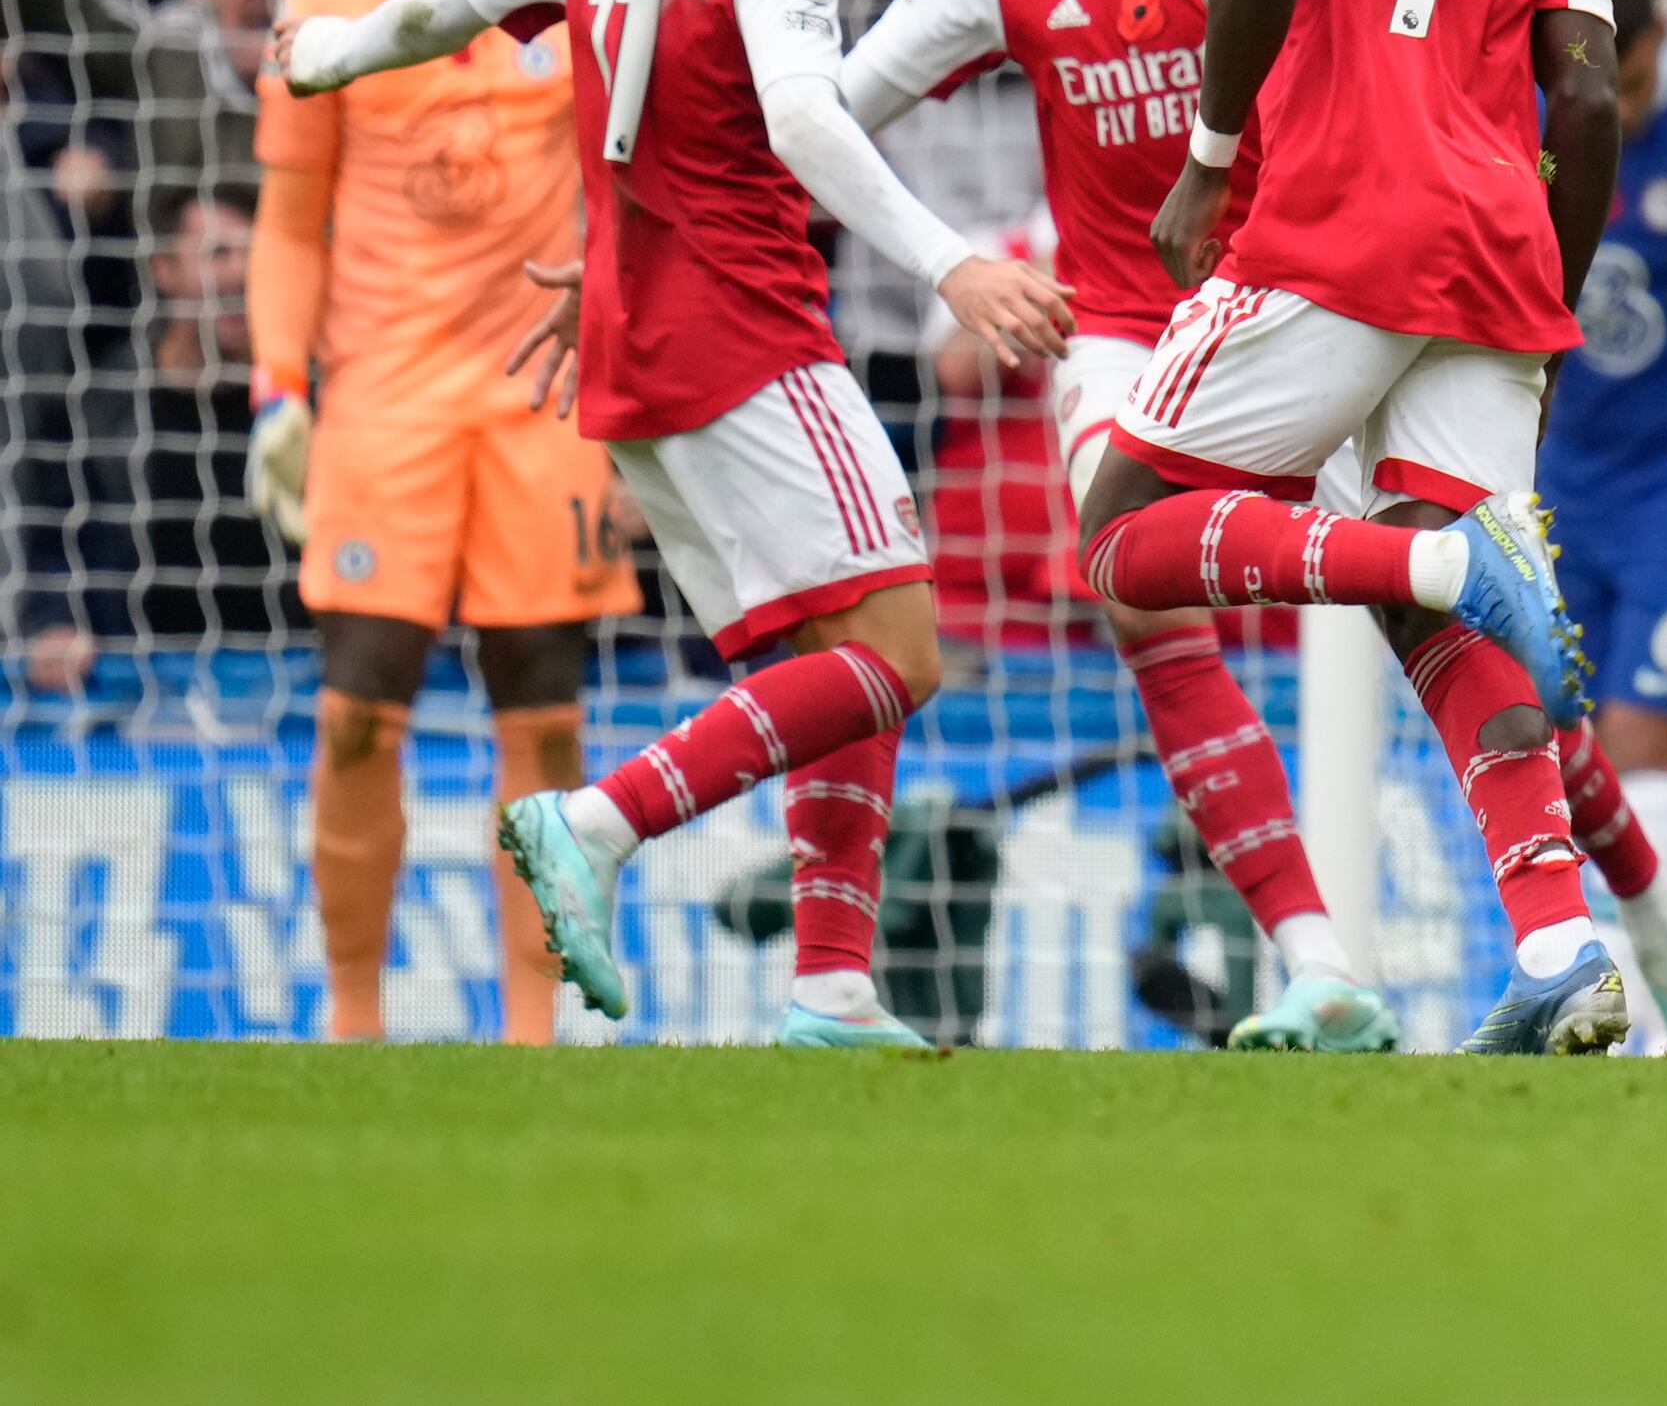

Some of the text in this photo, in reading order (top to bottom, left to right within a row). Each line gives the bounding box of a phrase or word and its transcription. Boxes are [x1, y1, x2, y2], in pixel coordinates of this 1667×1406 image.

[1053, 41, 1207, 106] Emira
[1094, 90, 1201, 148] FLY BET
